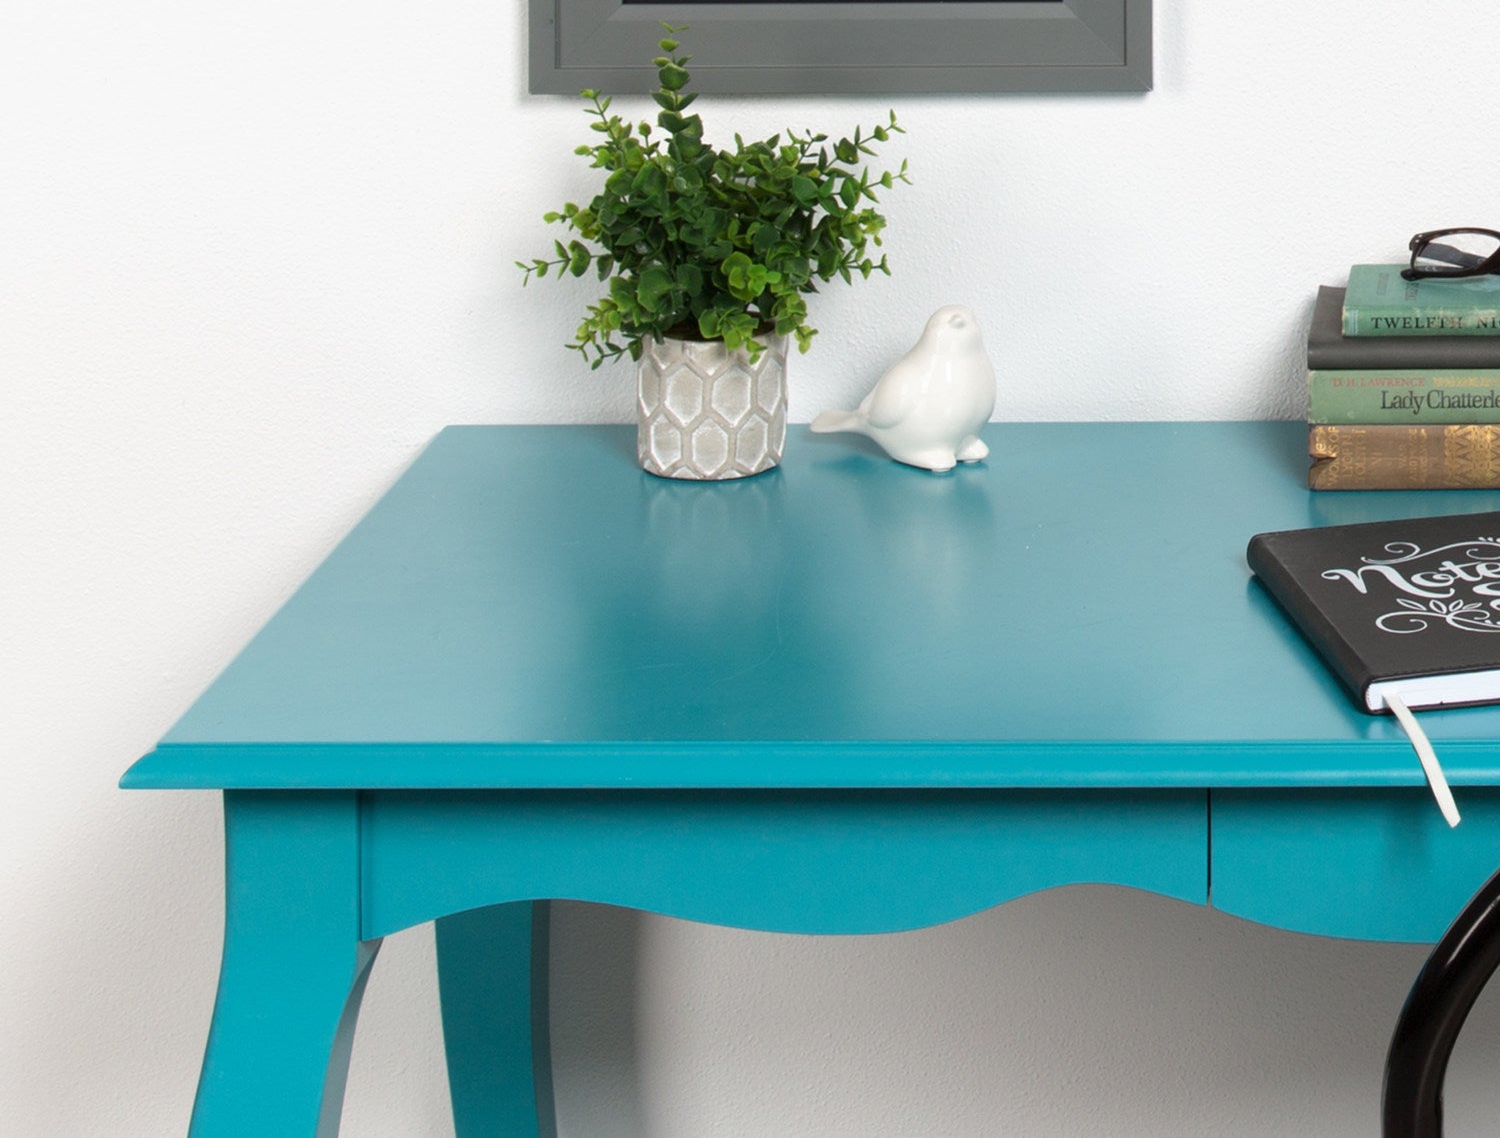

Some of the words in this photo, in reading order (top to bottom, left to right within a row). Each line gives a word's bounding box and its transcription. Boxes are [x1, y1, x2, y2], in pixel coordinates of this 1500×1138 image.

[1371, 317, 1463, 329] TWELFTH
[1360, 378, 1425, 387] LAWRENCE
[1381, 390, 1424, 414] Lady
